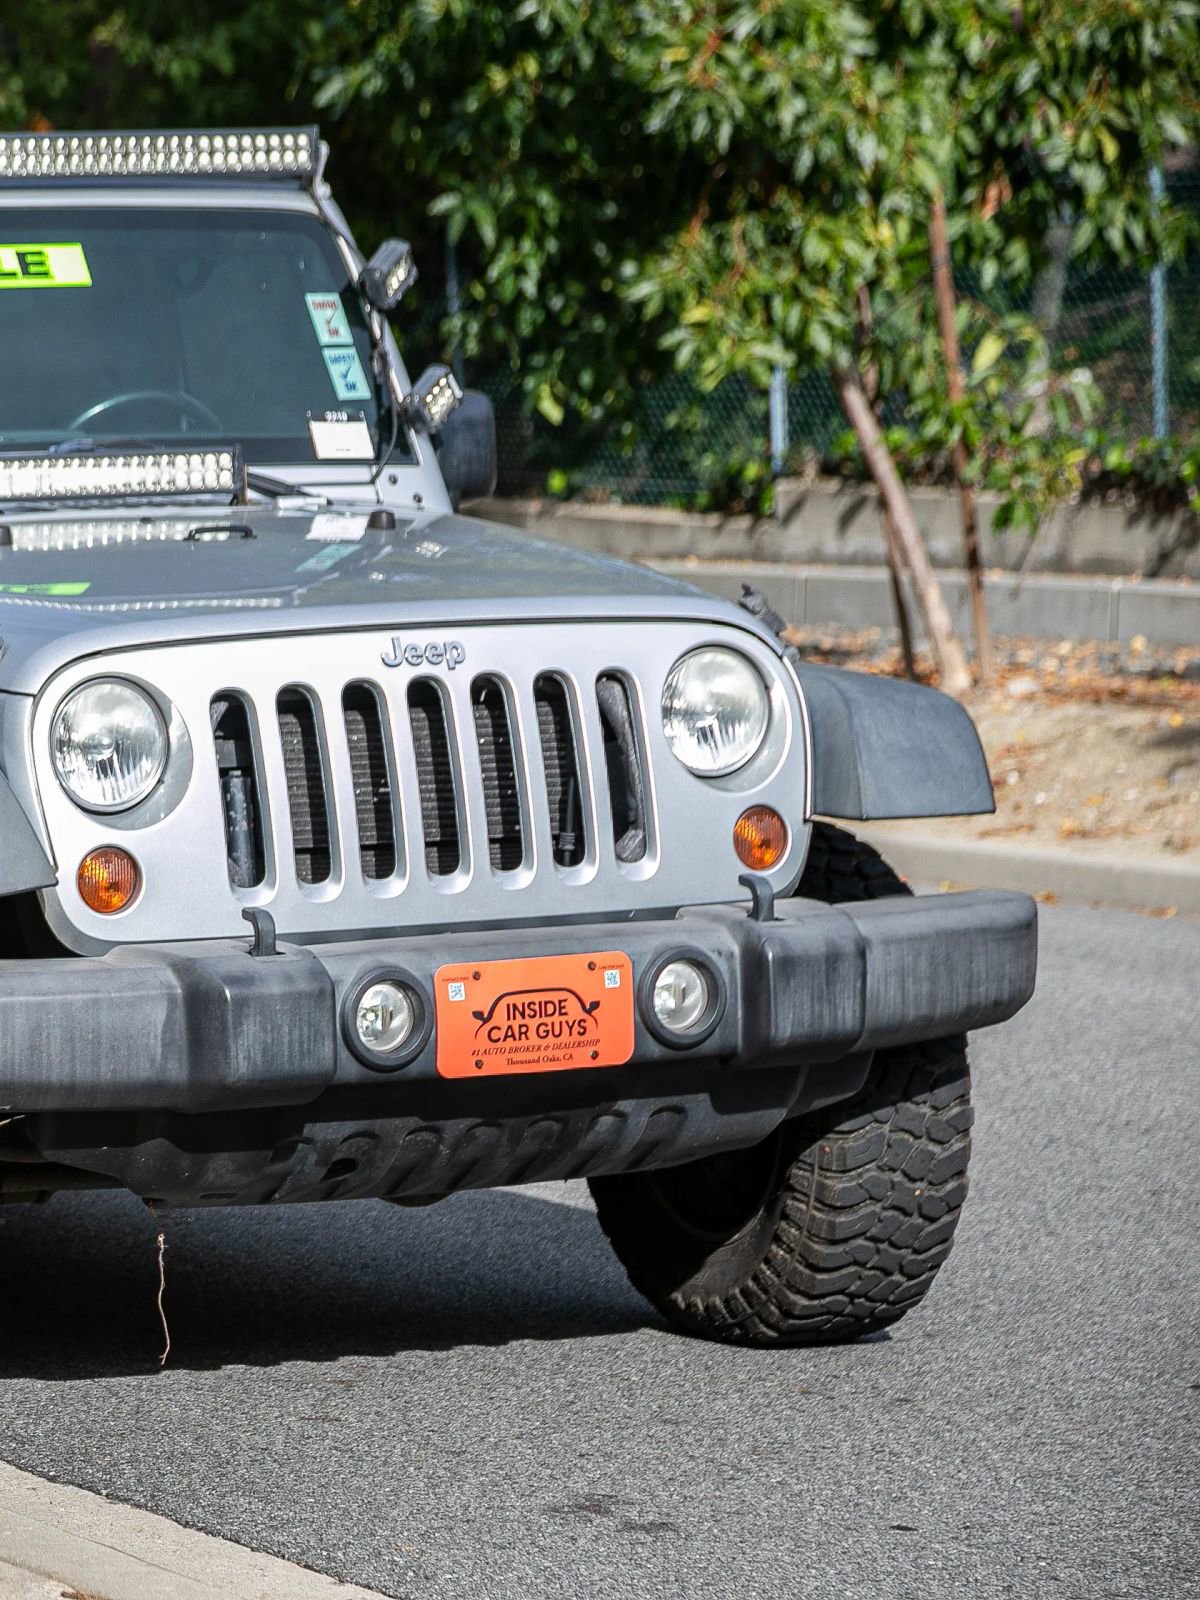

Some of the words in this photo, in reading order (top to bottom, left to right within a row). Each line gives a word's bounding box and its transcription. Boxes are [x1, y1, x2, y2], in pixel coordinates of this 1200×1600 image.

[380, 636, 466, 670] Jeep
[506, 998, 569, 1021] INSIDE
[487, 1024, 530, 1043] CAR
[535, 1019, 587, 1040] GUYS
[481, 1046, 507, 1057] AUTO
[508, 1043, 543, 1055] BROKER
[543, 1043, 551, 1052] &
[552, 1038, 601, 1050] DEALERSHIP
[505, 1055, 541, 1067] Thousand
[563, 1053, 574, 1061] CA
